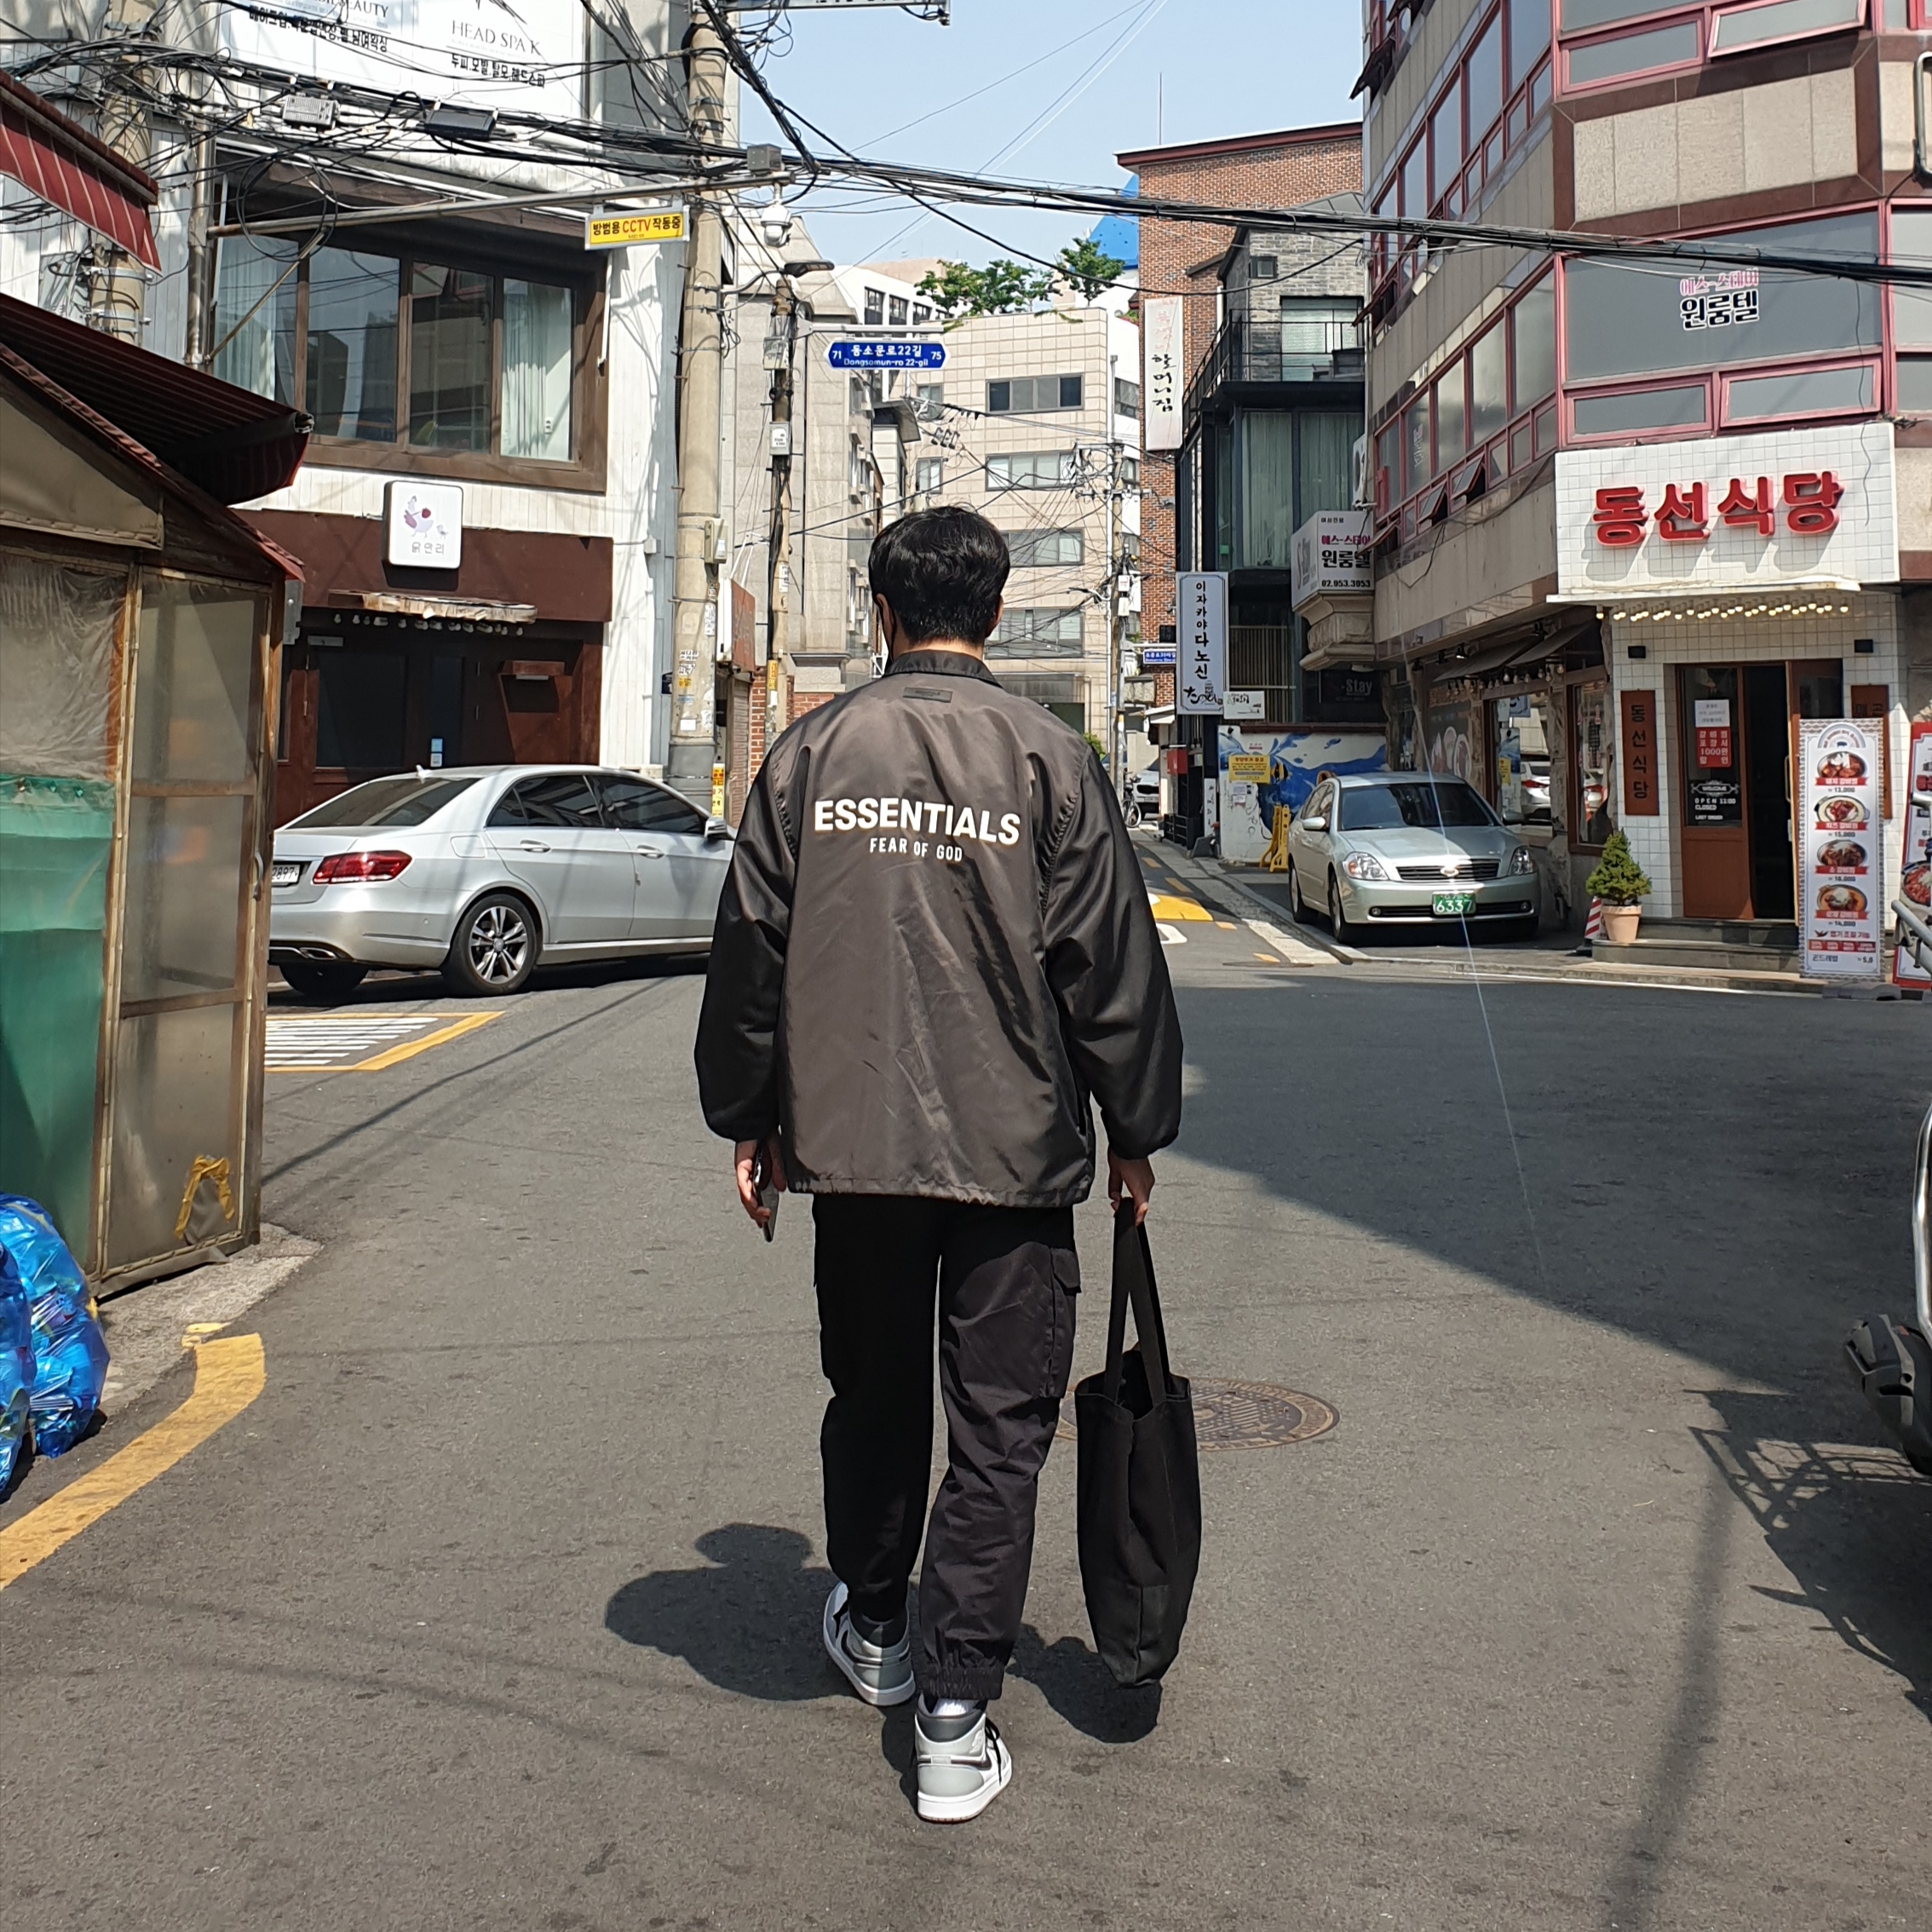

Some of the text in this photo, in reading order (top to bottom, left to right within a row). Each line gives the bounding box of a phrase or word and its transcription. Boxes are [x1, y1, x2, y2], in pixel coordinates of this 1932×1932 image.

[452, 20, 496, 43] HEAD
[501, 32, 526, 52] SPA
[593, 216, 681, 236] 방범용 CCTV 작동중
[1680, 289, 1759, 331] 원룸텔
[844, 359, 929, 367] Dongsomun-ro 22-gil
[851, 345, 922, 357] 동소문로22길
[931, 351, 941, 359] 75
[1592, 471, 1845, 547] 동선식당
[1194, 581, 1210, 680] 이자카야 다노신
[1631, 704, 1649, 799] 동선식당
[814, 797, 1021, 845] ESSENTIALS
[869, 837, 963, 862] FEAR OF GOD
[1436, 900, 1473, 912] 6337
